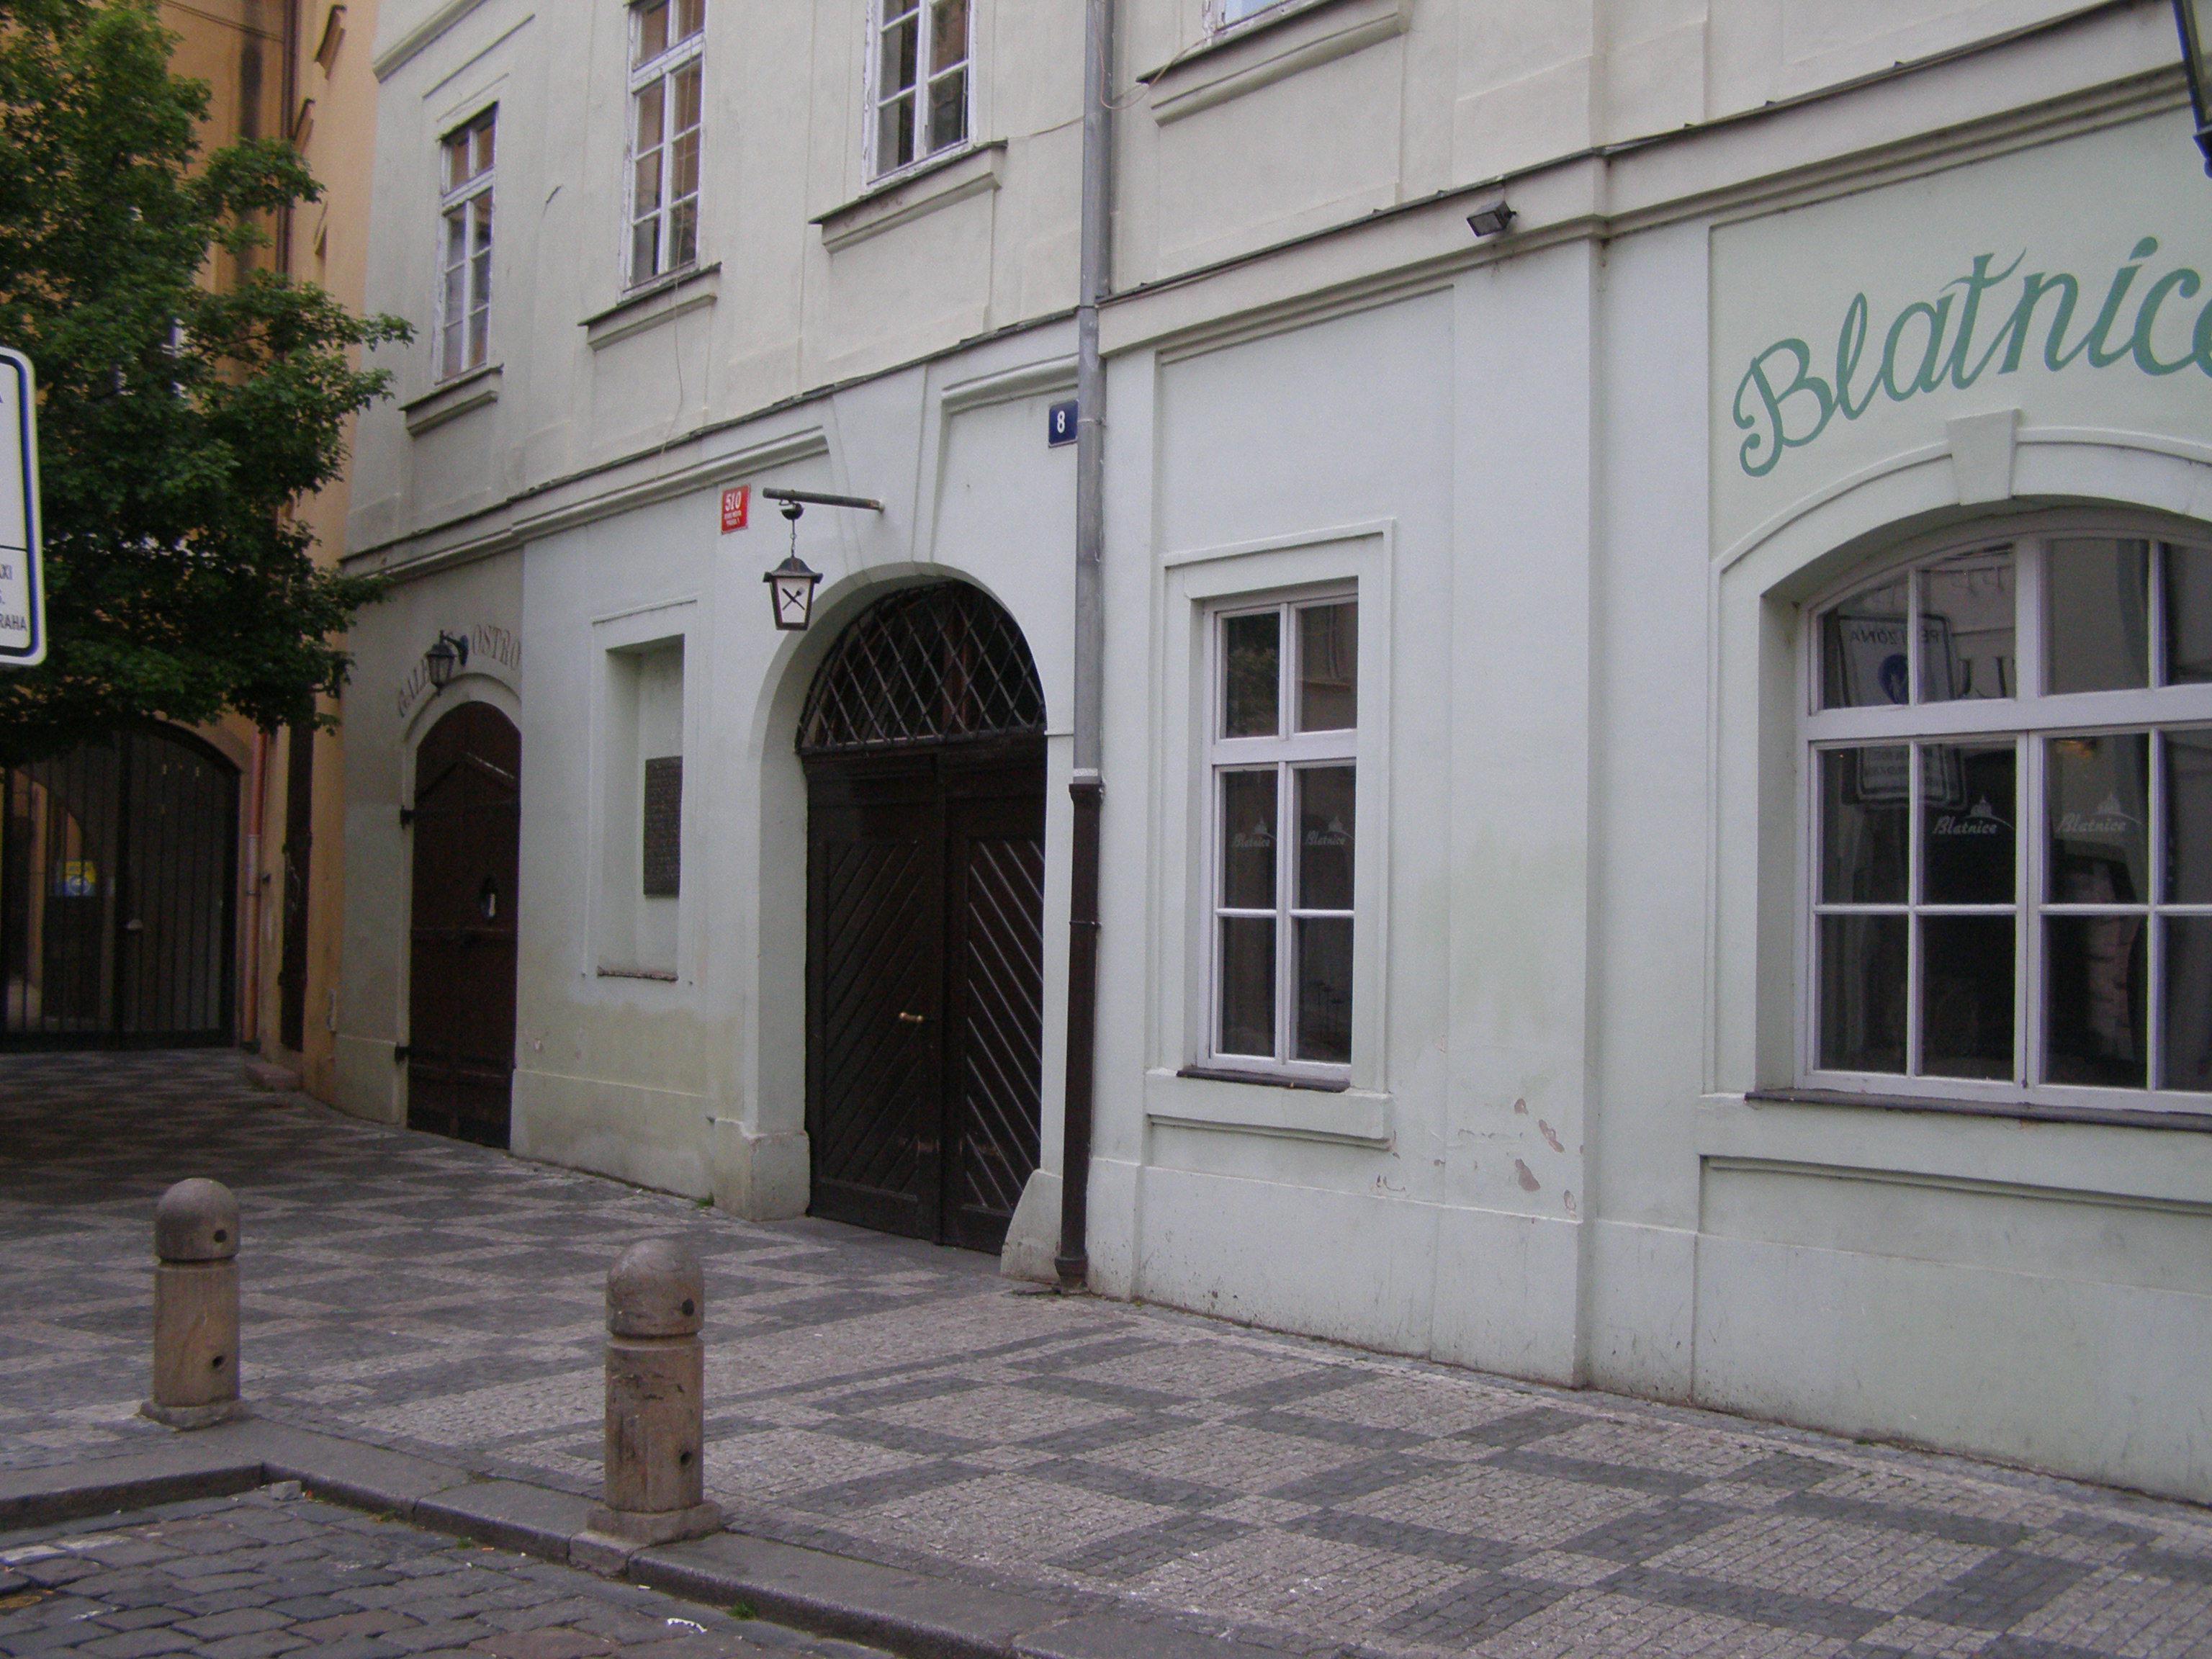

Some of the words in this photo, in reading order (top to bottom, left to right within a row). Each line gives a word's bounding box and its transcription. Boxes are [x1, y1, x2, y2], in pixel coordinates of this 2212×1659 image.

[1057, 410, 1065, 433] 8
[725, 490, 742, 512] 510
[1933, 815, 1997, 835] Blatnice
